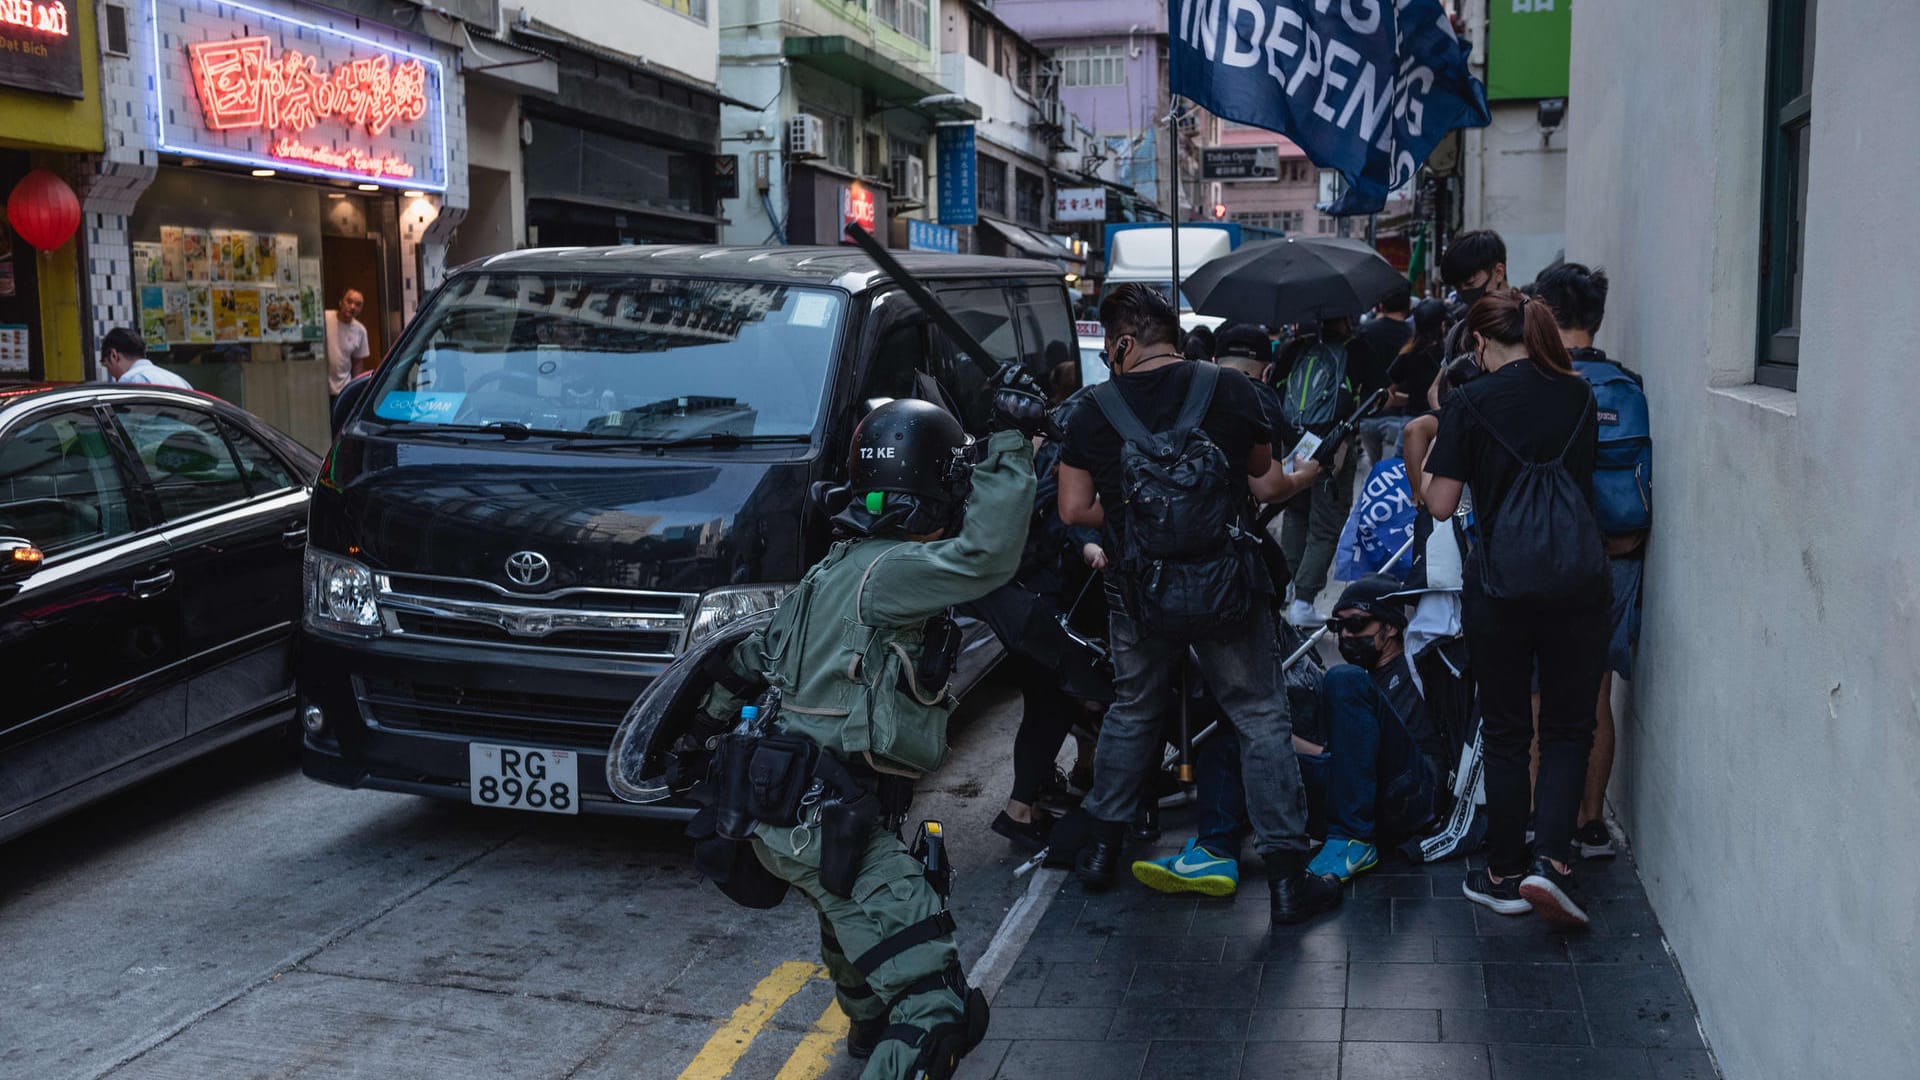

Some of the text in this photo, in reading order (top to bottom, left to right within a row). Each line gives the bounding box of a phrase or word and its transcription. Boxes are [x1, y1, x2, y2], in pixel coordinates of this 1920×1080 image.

[860, 447, 896, 459] T2 KE
[500, 748, 547, 780] RG
[478, 775, 571, 811] 8968
